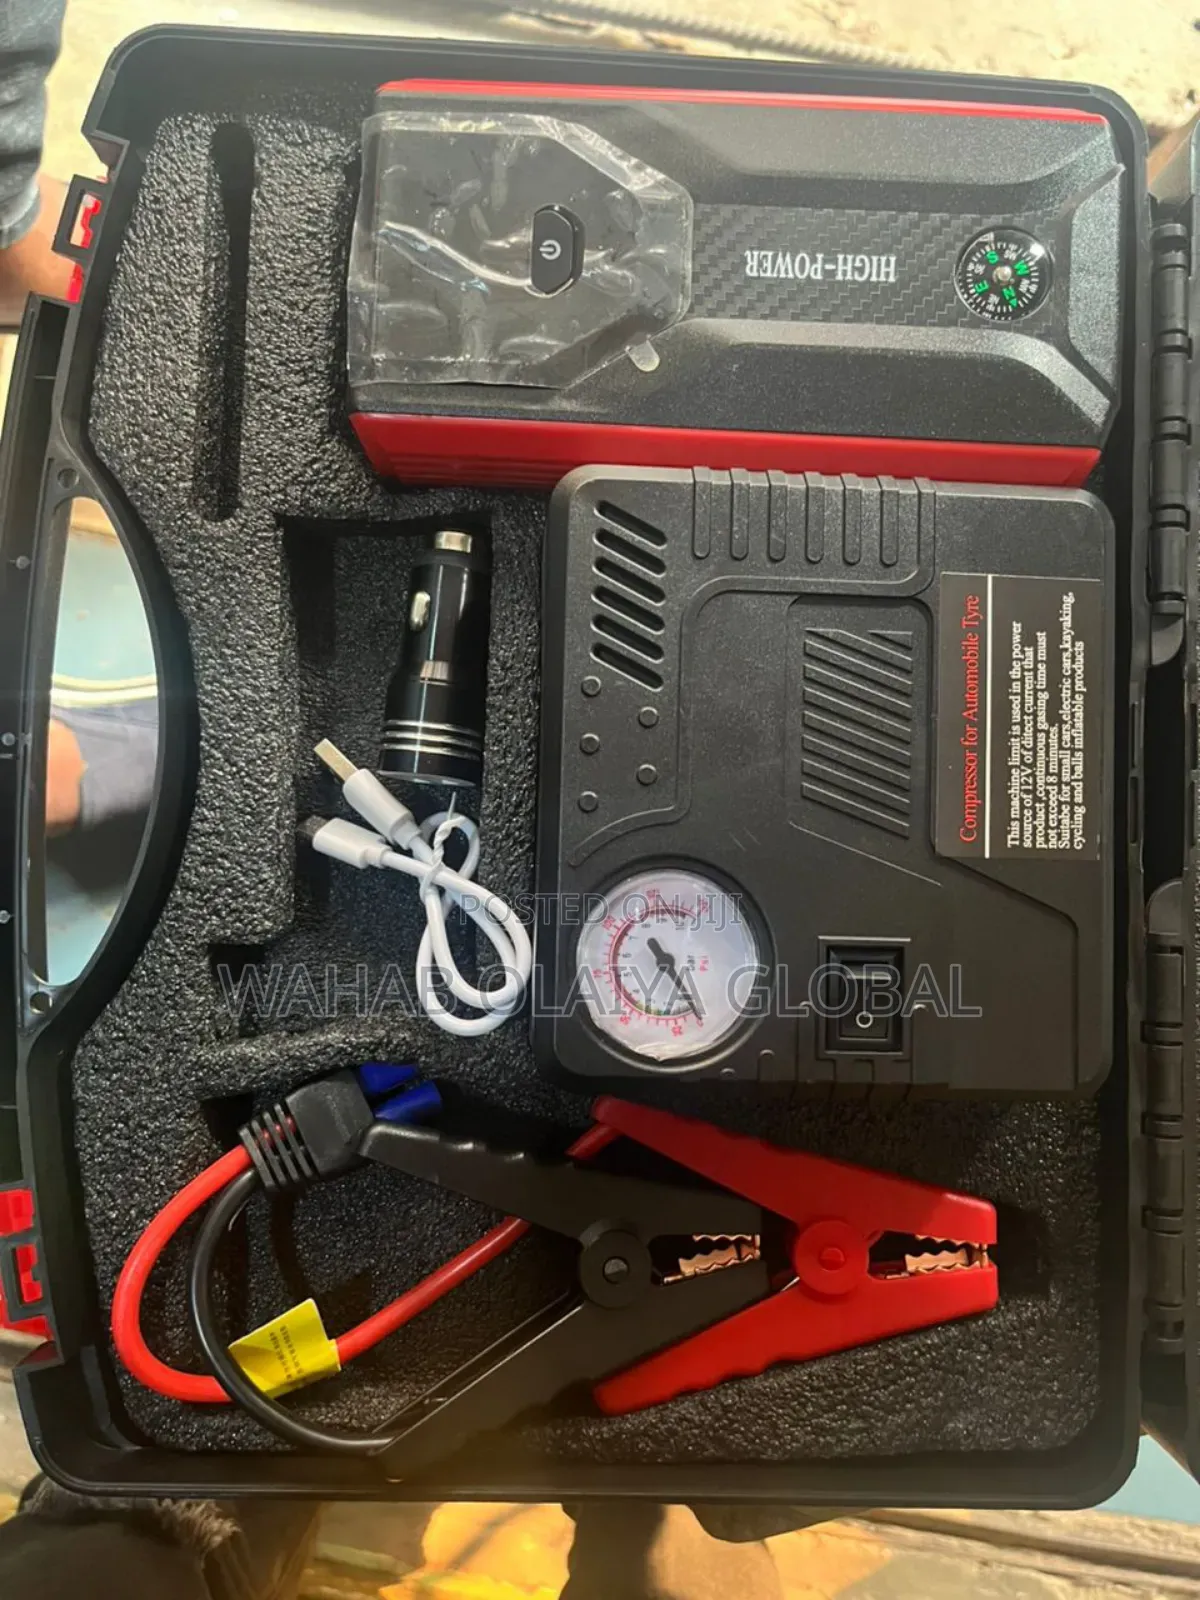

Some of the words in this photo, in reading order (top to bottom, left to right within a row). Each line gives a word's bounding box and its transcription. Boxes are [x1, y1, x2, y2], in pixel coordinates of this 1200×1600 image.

[744, 249, 897, 283] HIGH-POWER
[962, 595, 983, 628] Tyre
[1012, 621, 1024, 658] power
[1036, 631, 1046, 660] must
[1009, 661, 1021, 679] the
[1022, 646, 1033, 669] that
[1074, 641, 1087, 692] products
[961, 633, 979, 722] Automobile
[1009, 681, 1021, 692] in
[1035, 663, 1046, 689] time
[1024, 671, 1033, 713] current
[1009, 696, 1021, 722] used
[1035, 691, 1049, 730] gasing
[1071, 694, 1084, 749] inflatable
[961, 725, 978, 745] for
[1009, 725, 1021, 735] is
[1008, 738, 1020, 766] limit
[1021, 748, 1032, 763] of
[1046, 724, 1058, 773] minutes.
[1021, 766, 1032, 790] 12V
[1059, 750, 1070, 782] small
[1071, 751, 1083, 779] balls
[960, 750, 982, 842] Compressor
[1008, 768, 1020, 818] machine
[1021, 792, 1032, 806] of
[1046, 786, 1058, 827] exceed
[1059, 784, 1070, 802] for
[1071, 782, 1083, 803] and
[1007, 821, 1020, 848] This
[1023, 809, 1032, 848] source
[1033, 802, 1047, 849] product
[1048, 829, 1057, 849] not
[1059, 804, 1070, 849] Suitabe
[1071, 805, 1086, 850] cycling
